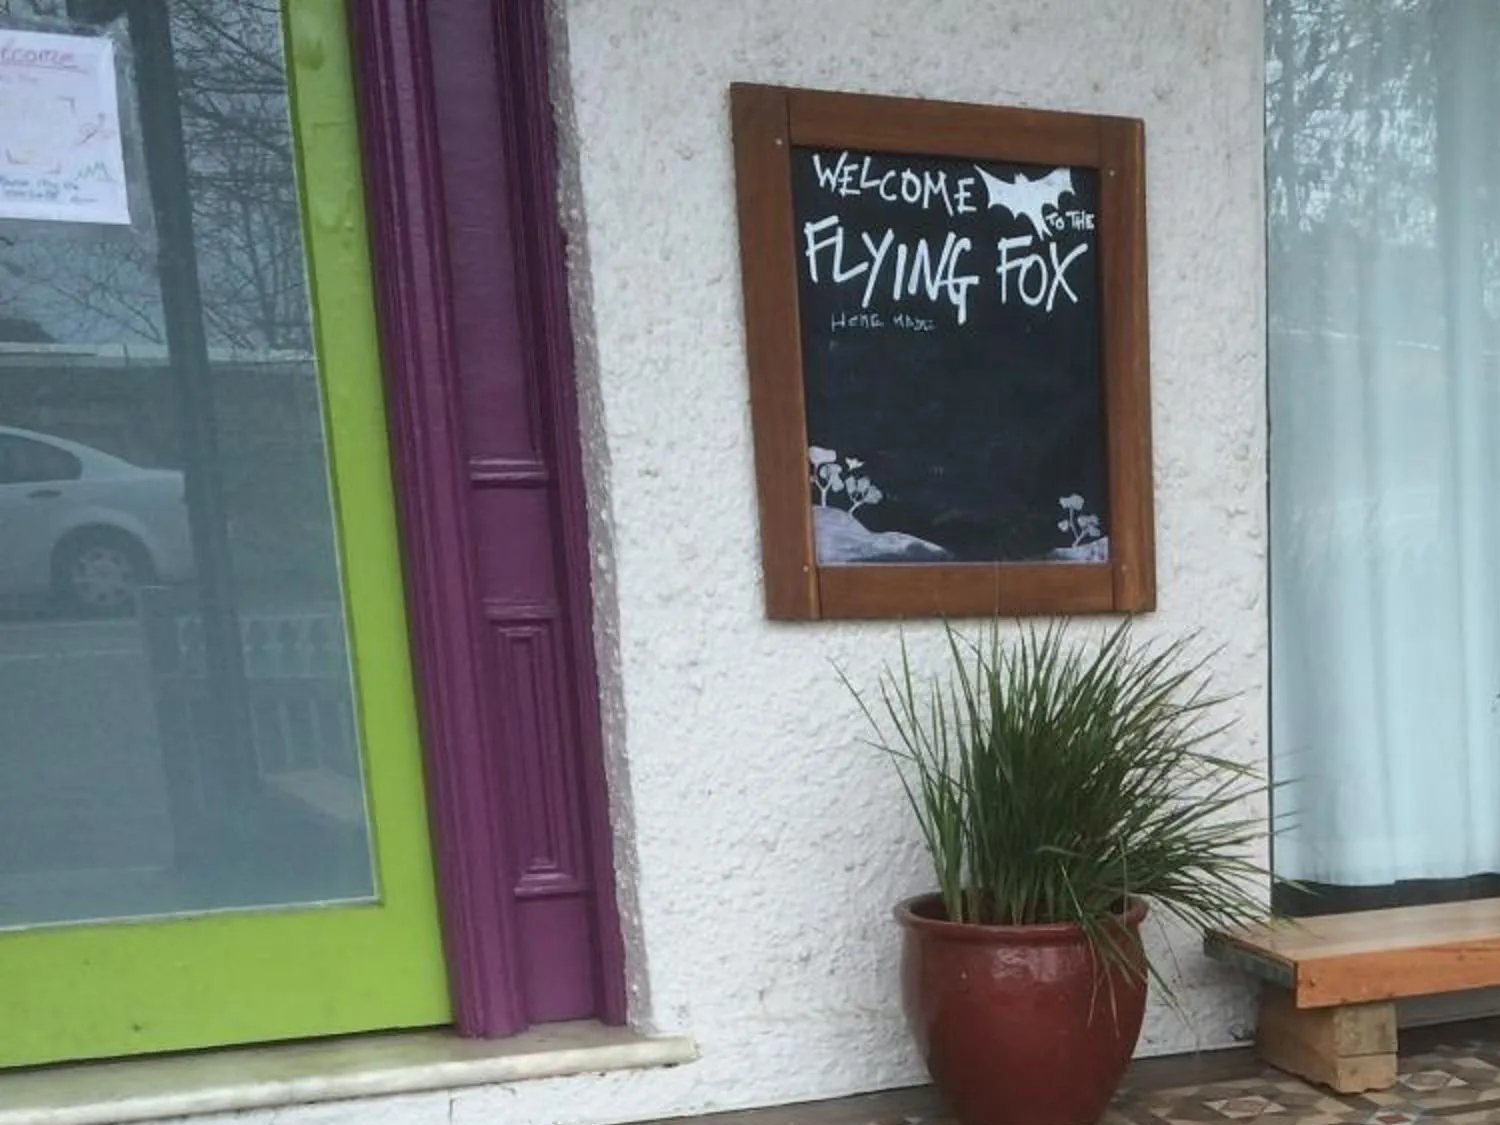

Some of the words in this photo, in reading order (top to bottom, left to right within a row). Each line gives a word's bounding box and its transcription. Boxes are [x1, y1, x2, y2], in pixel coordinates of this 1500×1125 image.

[812, 151, 977, 216] WELCOME
[1045, 212, 1065, 230] TO
[1065, 210, 1095, 231] THE
[804, 215, 980, 325] FLYING
[996, 235, 1088, 312] FOX
